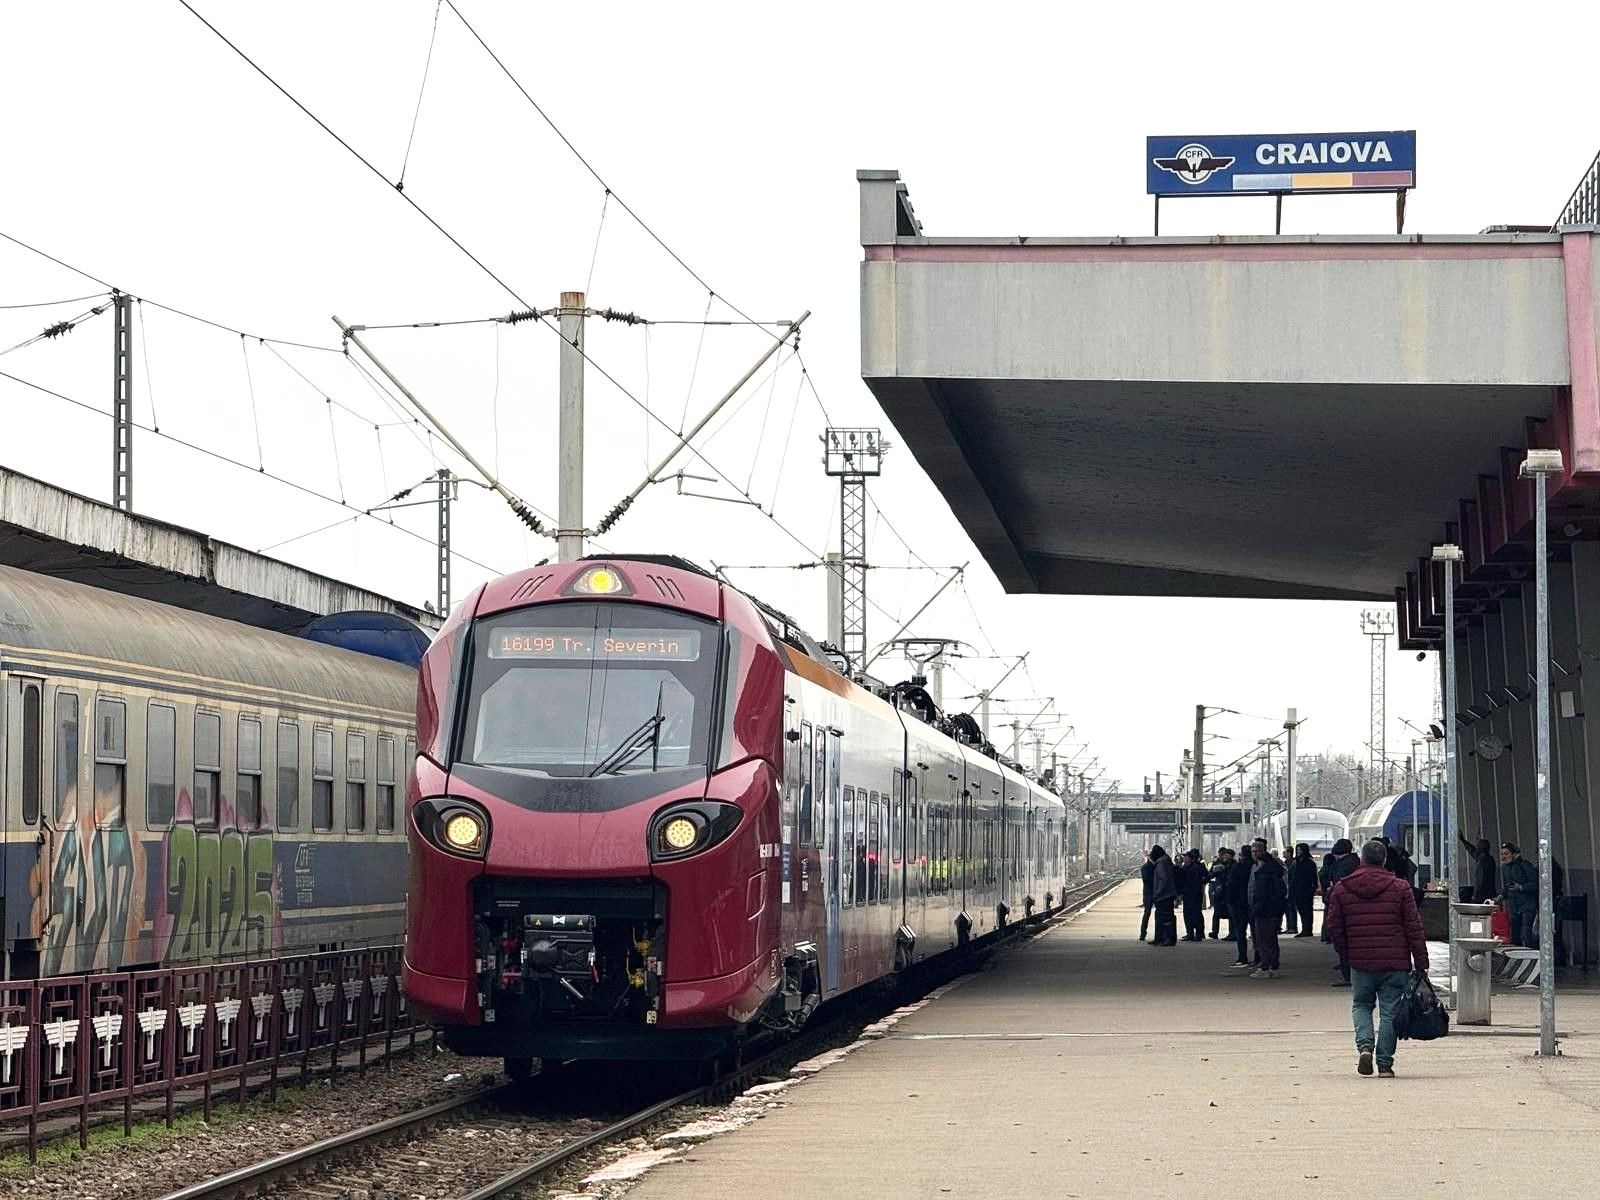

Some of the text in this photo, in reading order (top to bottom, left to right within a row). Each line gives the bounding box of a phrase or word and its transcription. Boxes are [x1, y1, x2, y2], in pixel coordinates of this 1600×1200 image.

[1185, 150, 1203, 159] CFR
[1255, 141, 1393, 165] CRAIOVA
[502, 637, 679, 653] 16199 Tr. Severin
